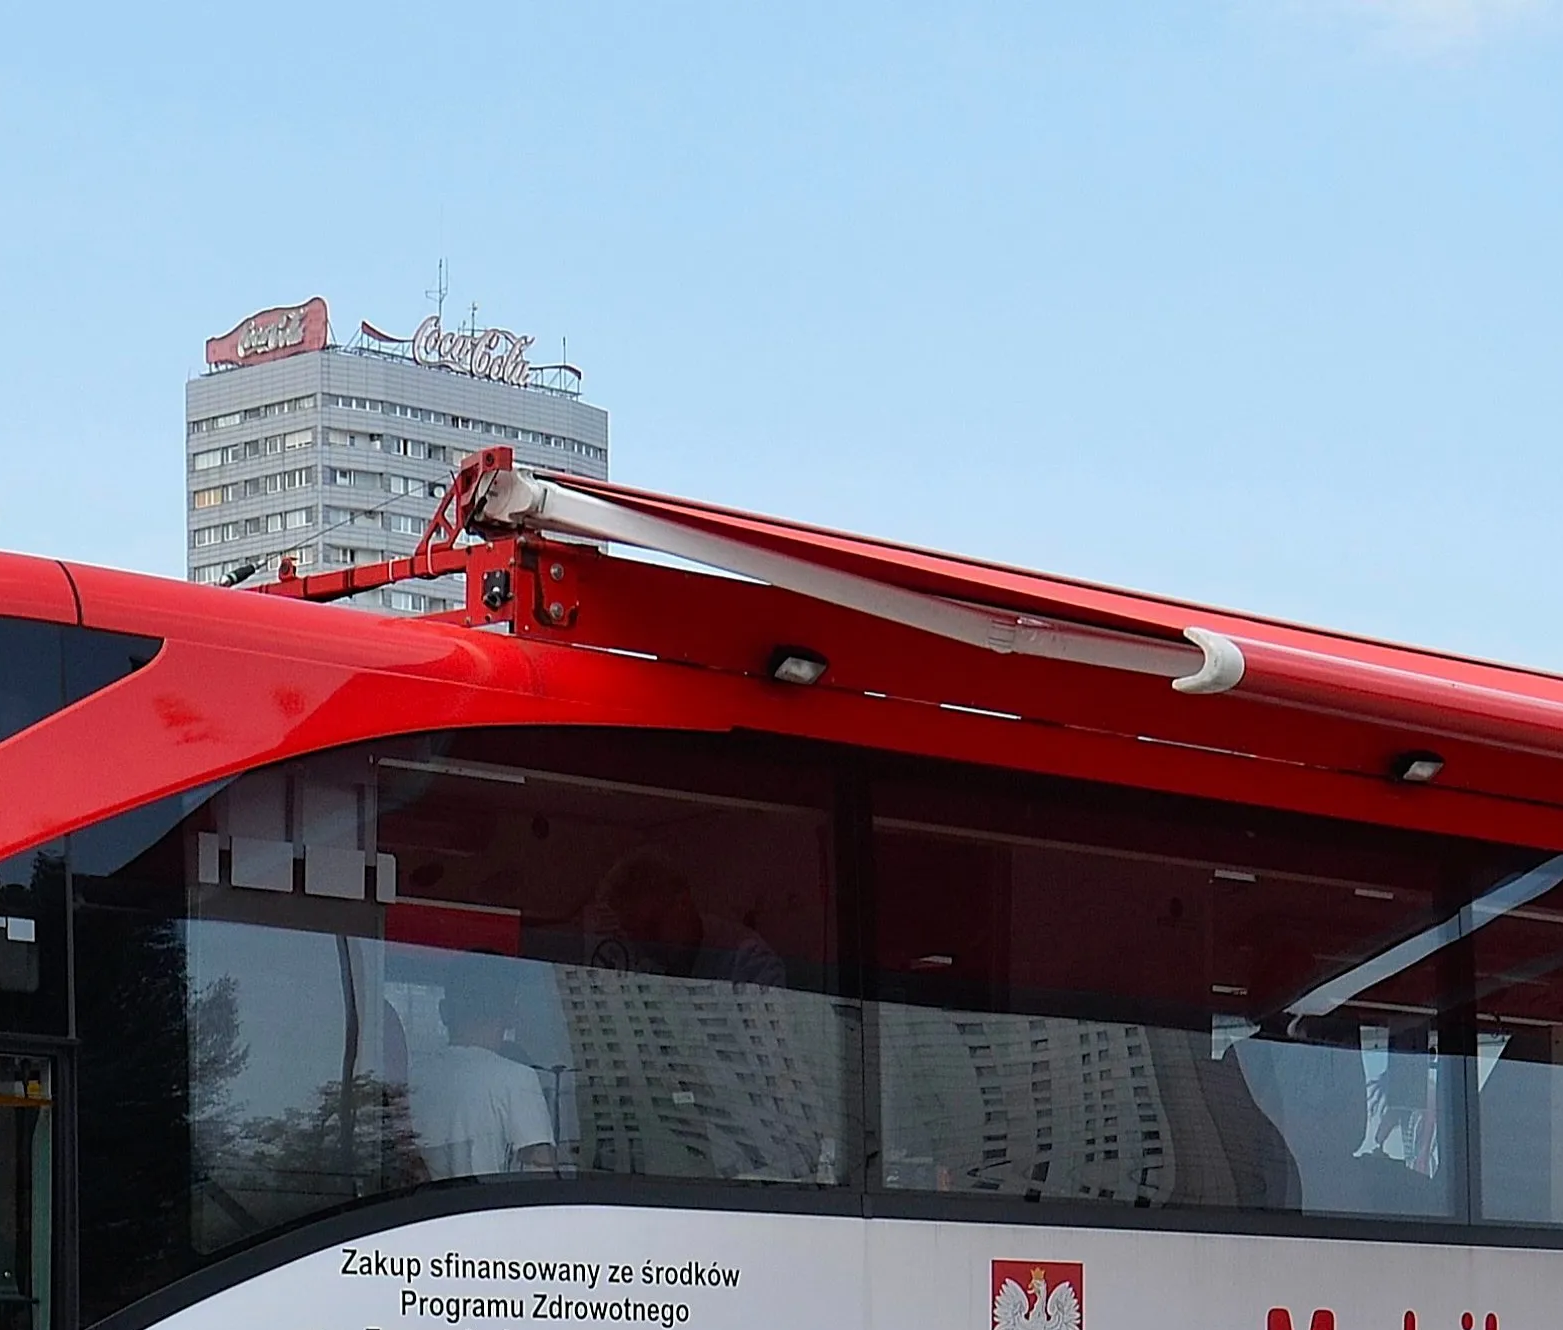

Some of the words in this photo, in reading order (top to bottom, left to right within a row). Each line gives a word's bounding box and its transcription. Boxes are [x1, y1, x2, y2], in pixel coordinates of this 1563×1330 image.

[341, 1249, 422, 1282] Zakup
[429, 1253, 600, 1289] sfinansowany
[608, 1263, 634, 1284] ze
[641, 1258, 741, 1288] środków
[400, 1290, 525, 1323] Programu
[532, 1293, 690, 1329] Zdrowotnego
